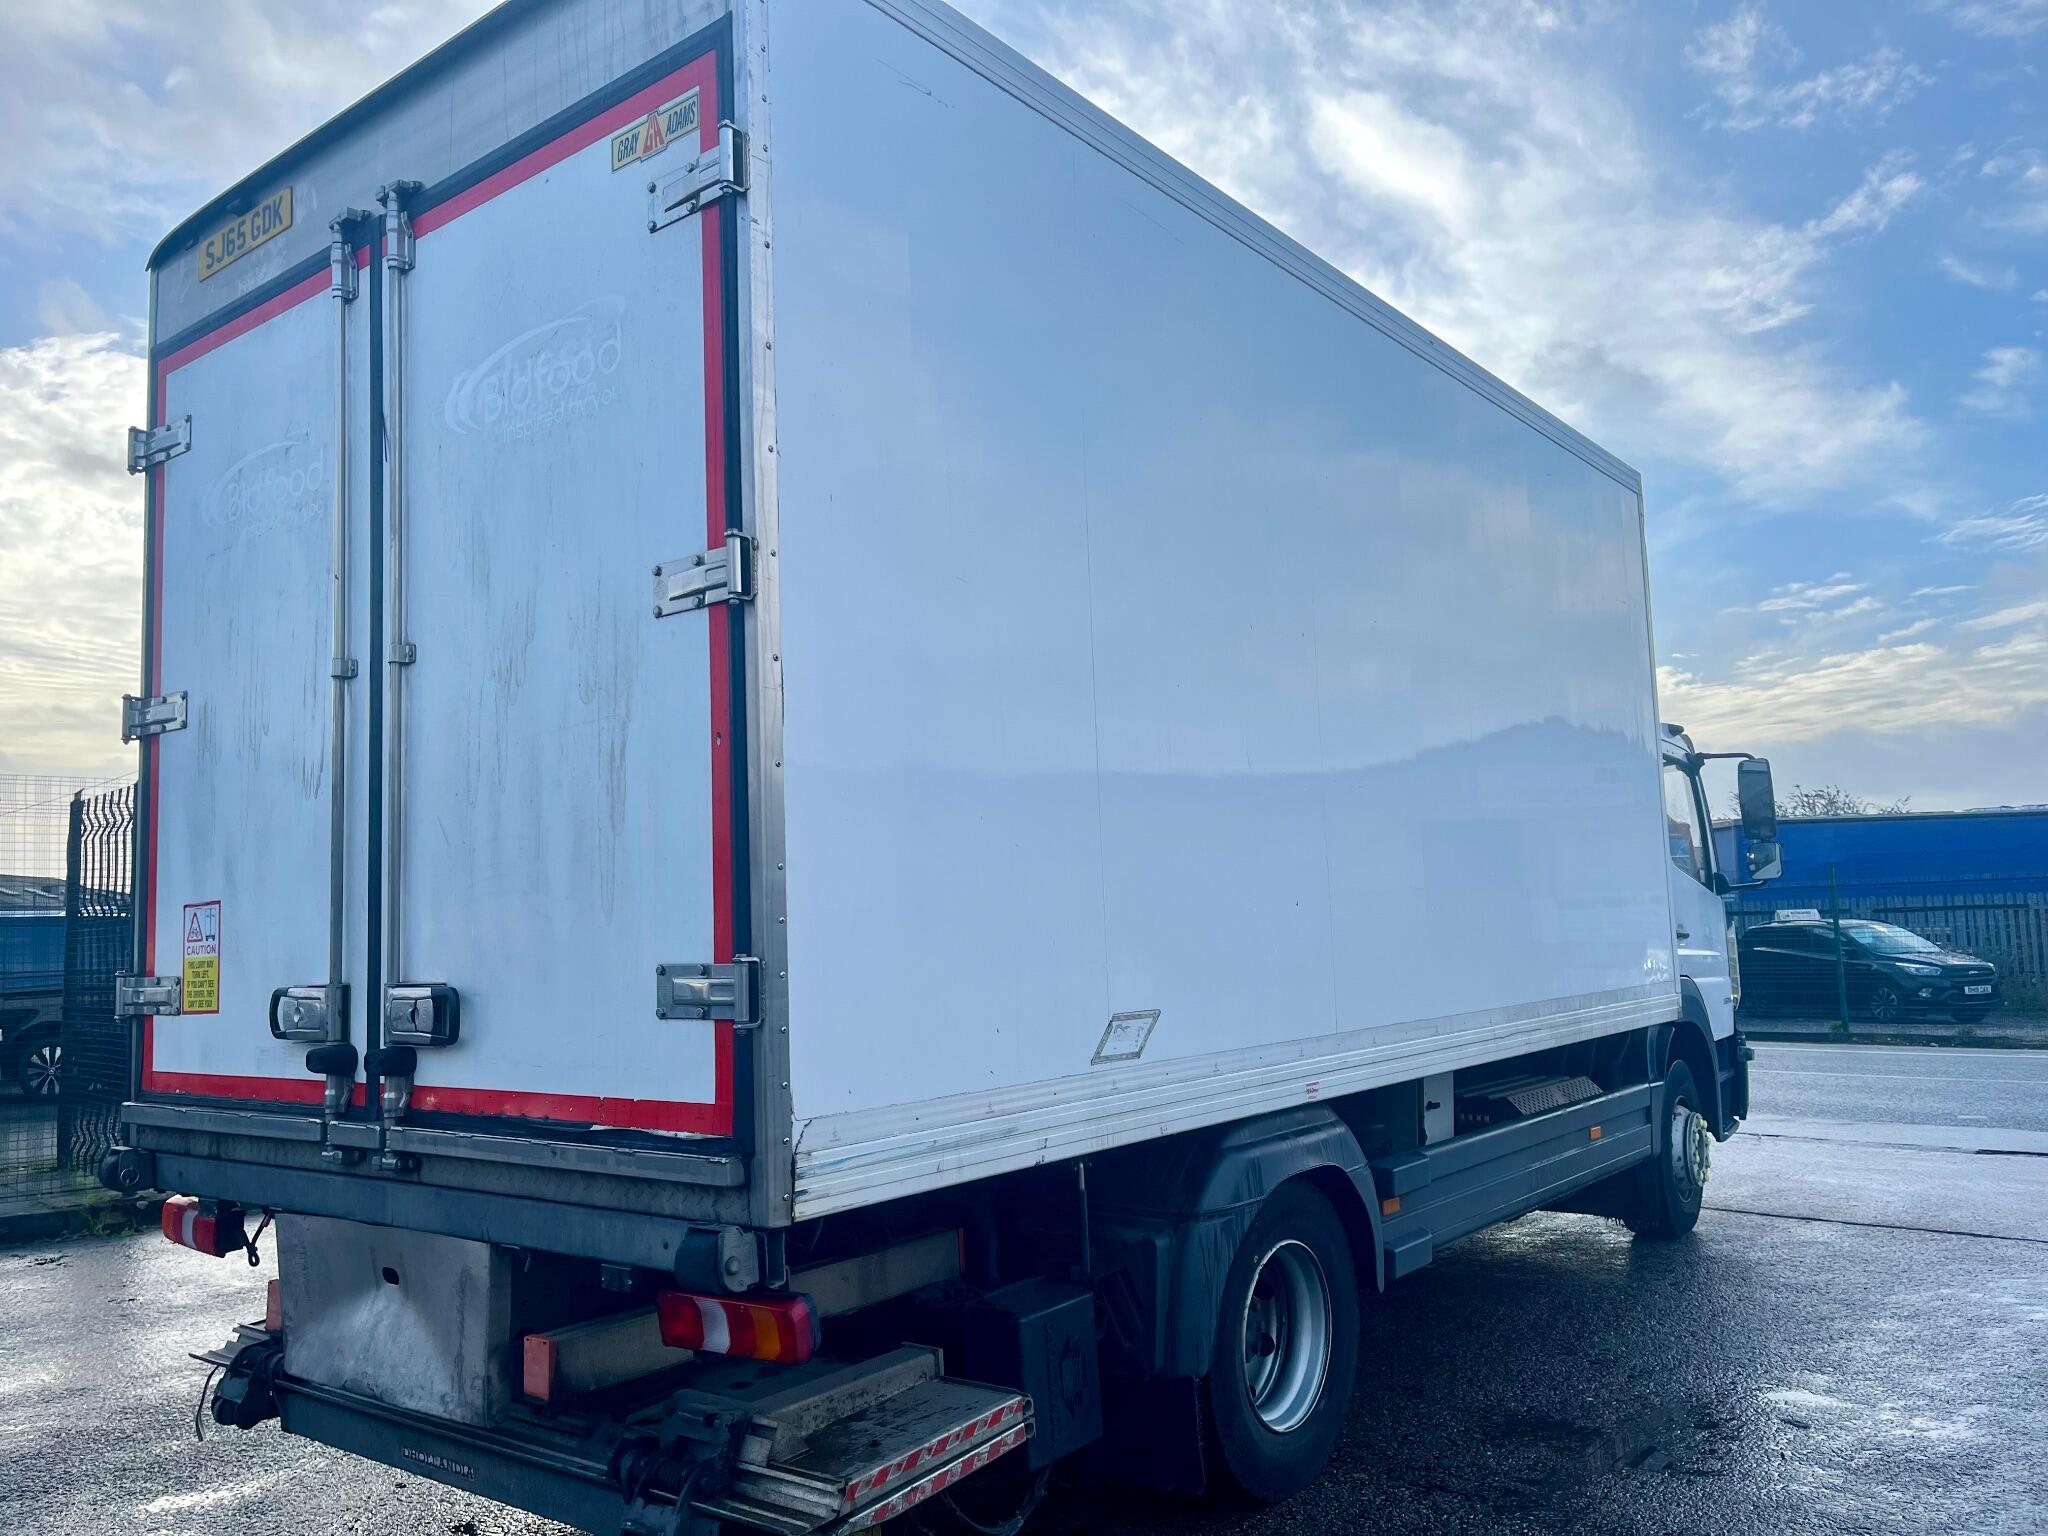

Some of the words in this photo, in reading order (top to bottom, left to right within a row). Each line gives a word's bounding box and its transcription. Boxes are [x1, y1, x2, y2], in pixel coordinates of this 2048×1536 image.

[617, 131, 640, 163] GRAY
[665, 100, 696, 137] ADAMS
[206, 219, 246, 270] SJ65
[251, 195, 284, 242] GDK
[186, 944, 216, 955] CAUTION
